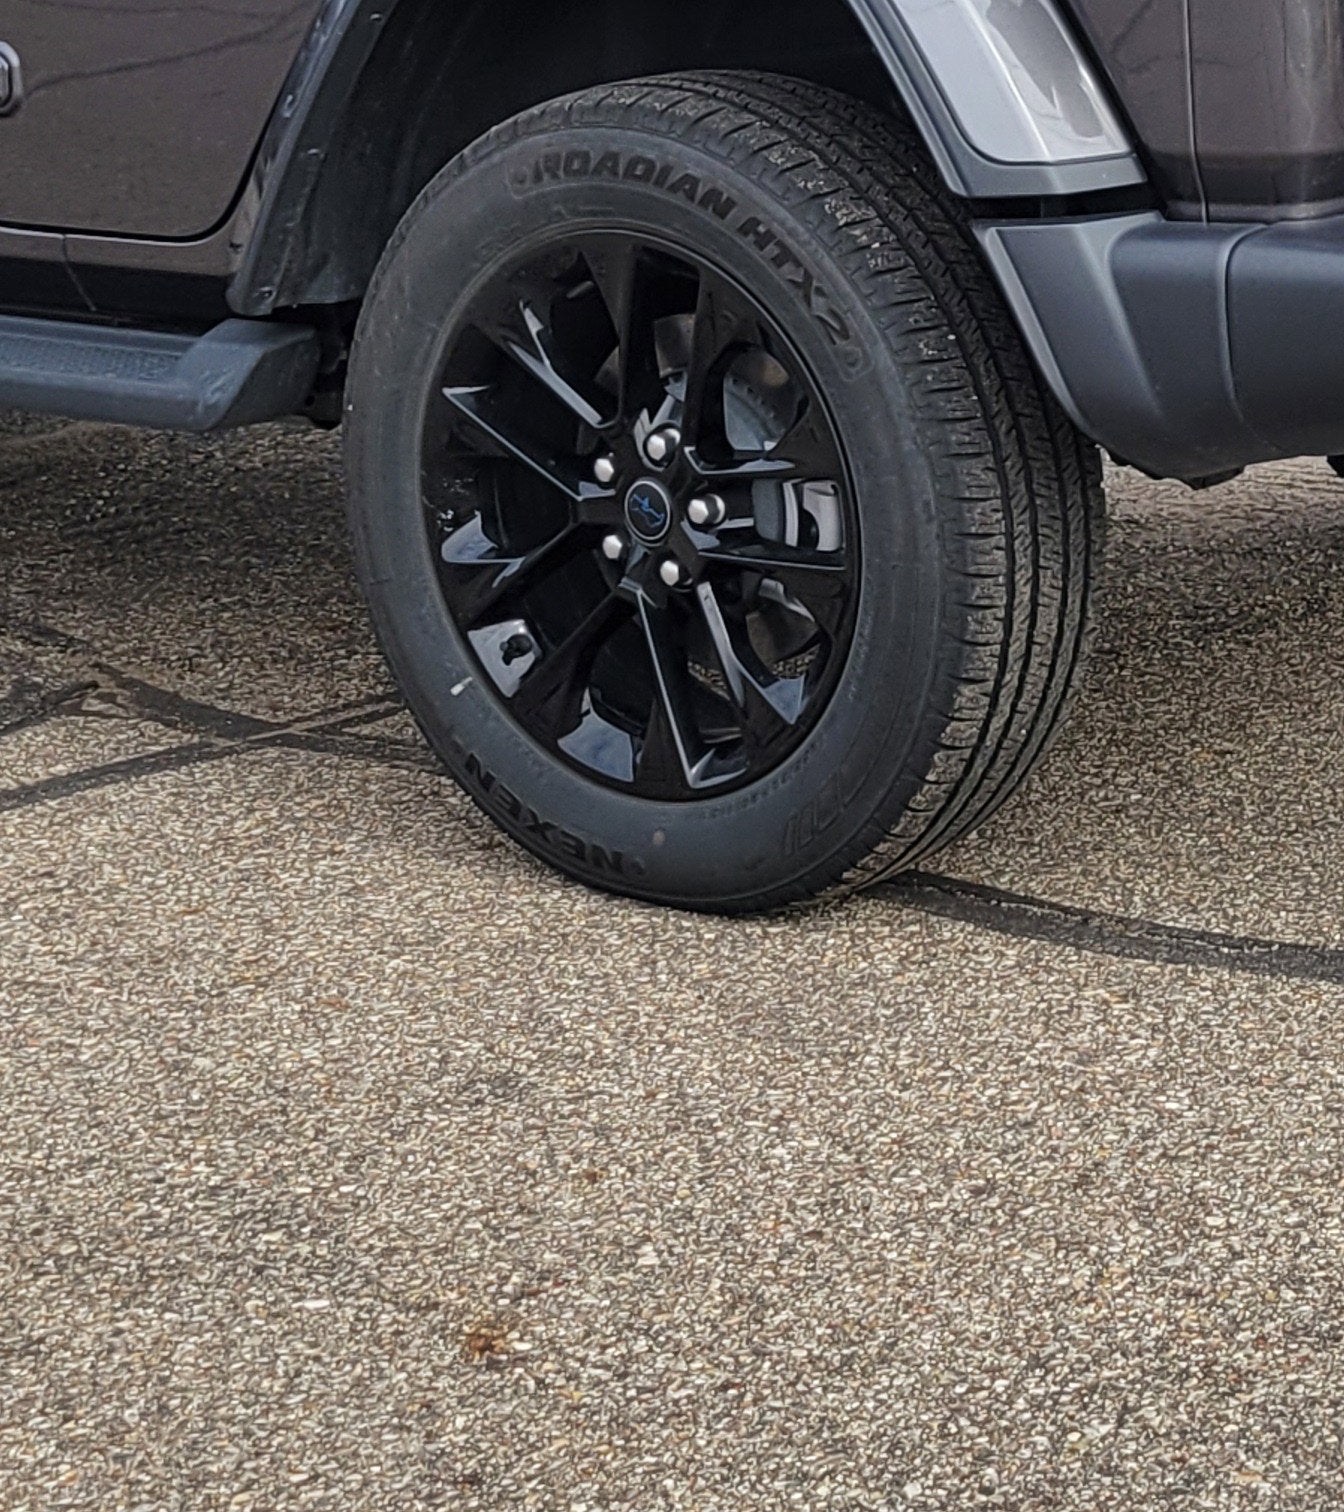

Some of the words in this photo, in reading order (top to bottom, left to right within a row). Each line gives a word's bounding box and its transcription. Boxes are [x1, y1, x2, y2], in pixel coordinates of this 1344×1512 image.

[532, 149, 738, 221] ROADIAN
[735, 216, 852, 346] HTX2
[464, 751, 625, 875] NEXEN
